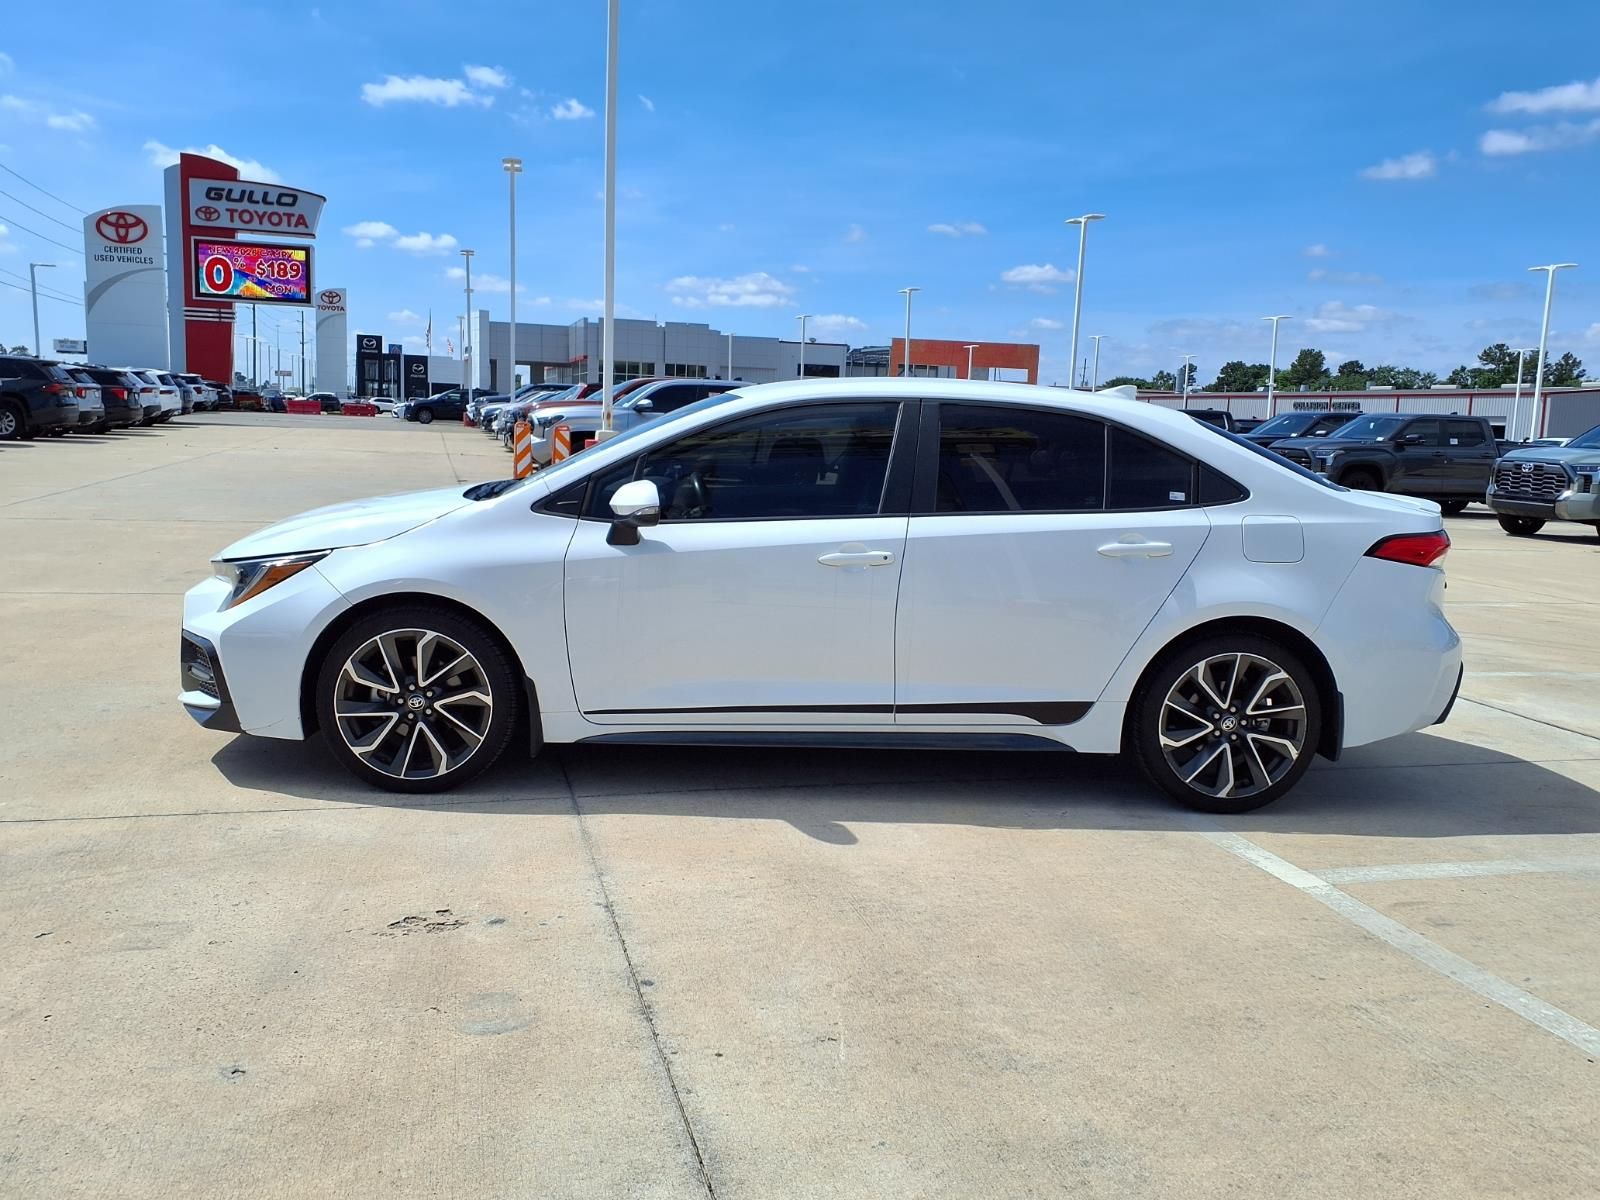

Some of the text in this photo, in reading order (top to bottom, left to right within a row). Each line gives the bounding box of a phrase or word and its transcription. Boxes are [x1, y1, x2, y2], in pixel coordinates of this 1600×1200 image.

[205, 186, 298, 207] GULLO
[225, 208, 309, 229] TOYOTA
[104, 245, 143, 255] CERTIFIED
[94, 254, 154, 265] USED VEHICLES
[255, 258, 302, 280] $189
[316, 304, 345, 312] TOYOTA
